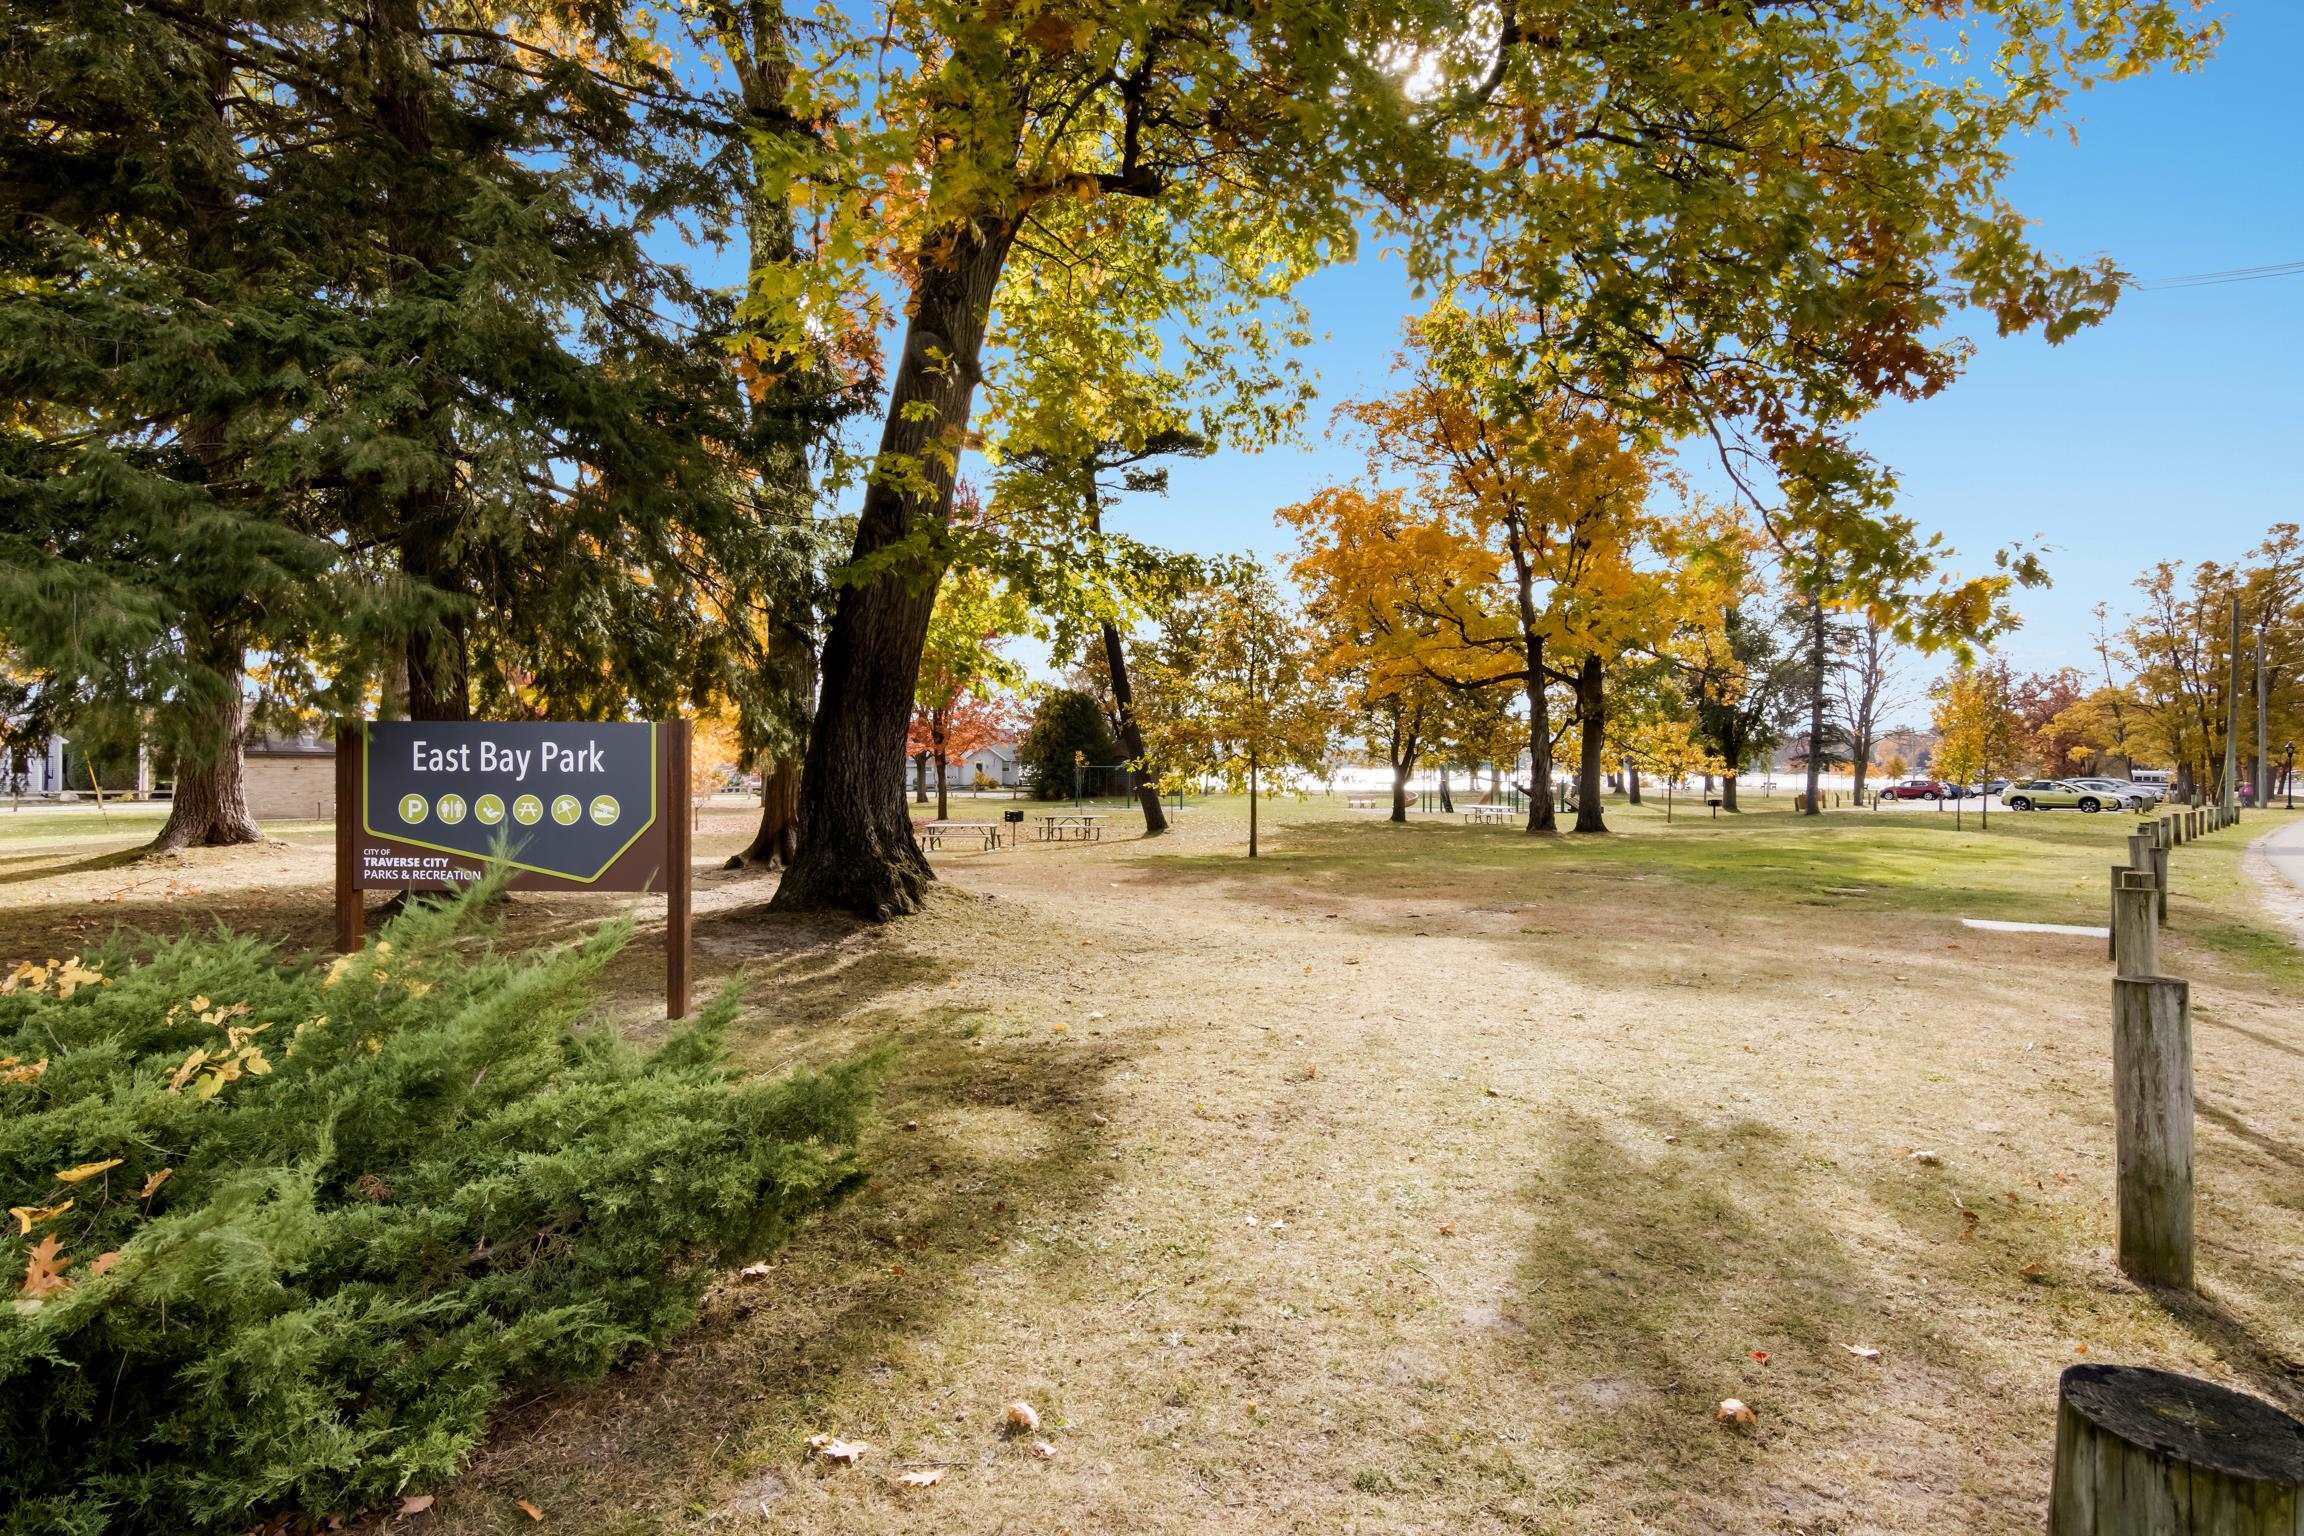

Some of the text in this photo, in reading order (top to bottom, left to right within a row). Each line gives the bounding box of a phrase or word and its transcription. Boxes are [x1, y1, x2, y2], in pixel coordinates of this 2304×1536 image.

[413, 740, 605, 782] East Bay Park
[408, 799, 422, 818] P
[363, 848, 391, 856] CITY OF
[363, 857, 449, 868] TRAVERSE CITY
[364, 869, 481, 880] PARKS & RECREATION
